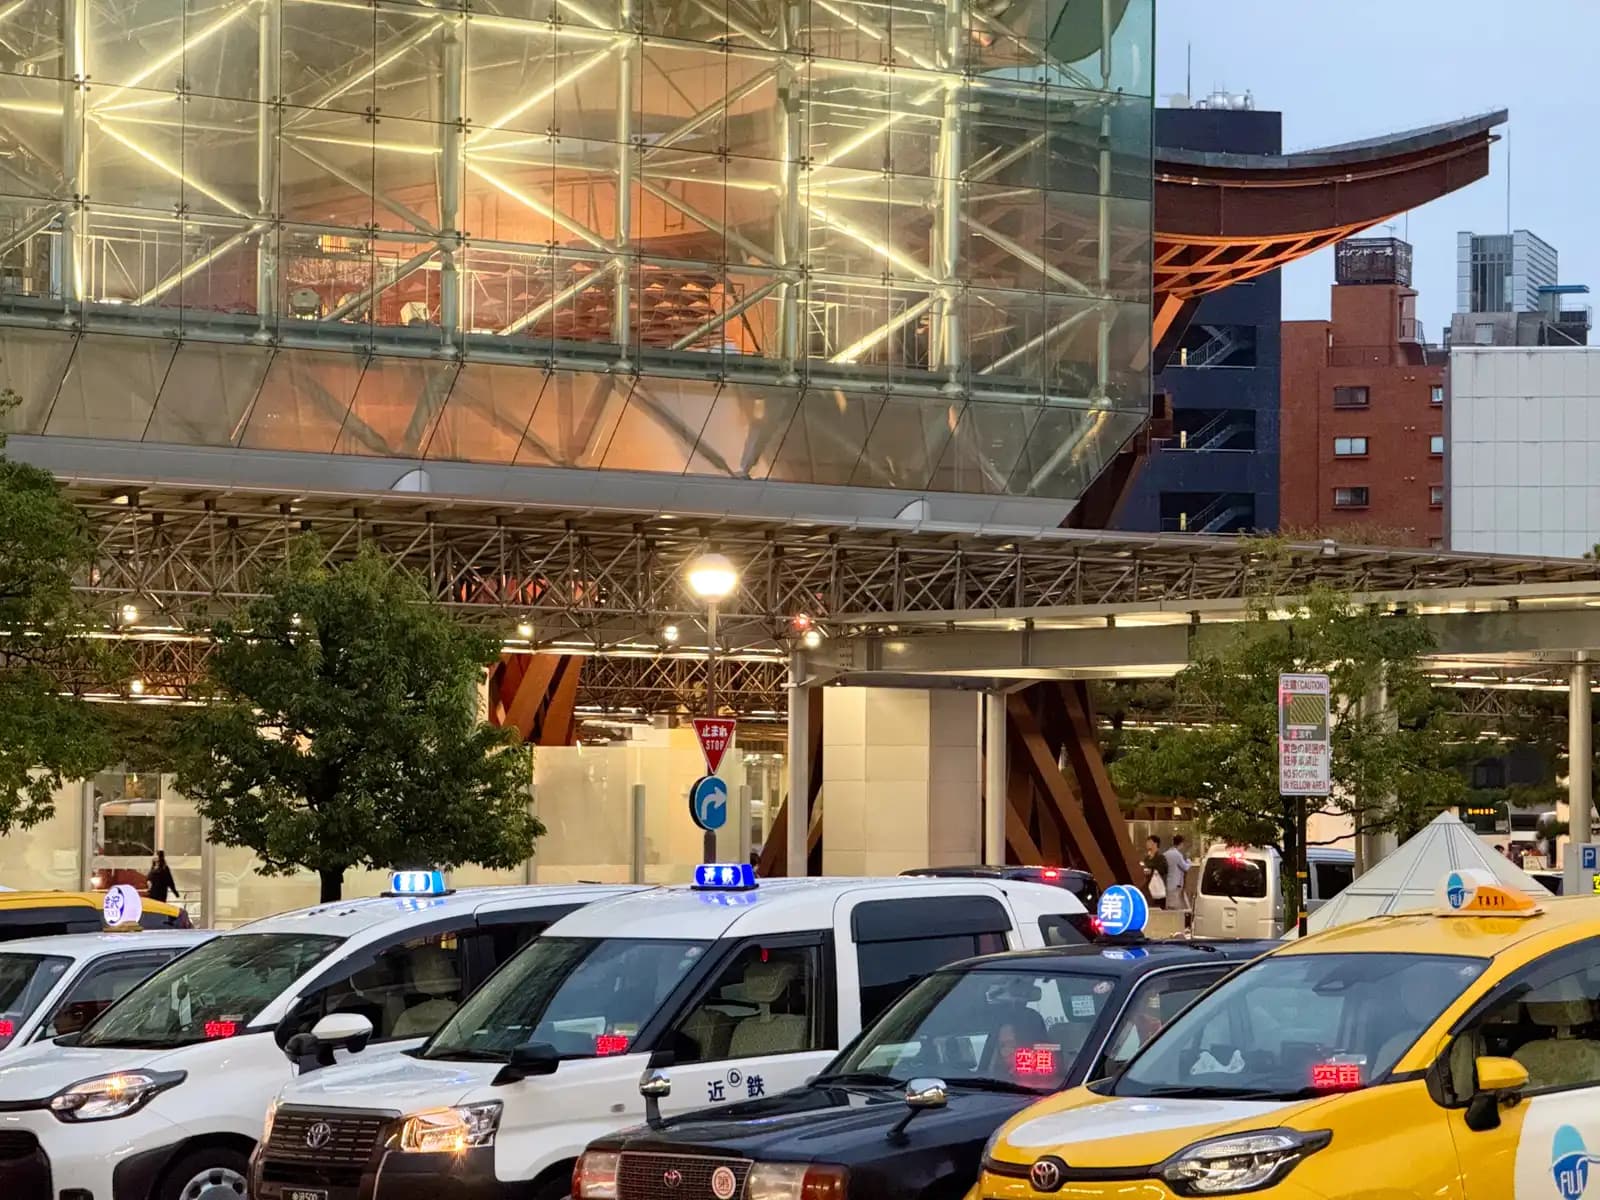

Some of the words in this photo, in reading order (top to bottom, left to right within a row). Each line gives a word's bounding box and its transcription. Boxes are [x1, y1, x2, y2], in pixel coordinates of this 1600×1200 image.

[702, 725, 728, 737] 止まれ
[705, 740, 724, 750] STOP
[1584, 849, 1595, 867] P
[1478, 895, 1504, 906] TAXI
[1016, 1048, 1053, 1073] 空車
[1313, 1064, 1359, 1088] 空車
